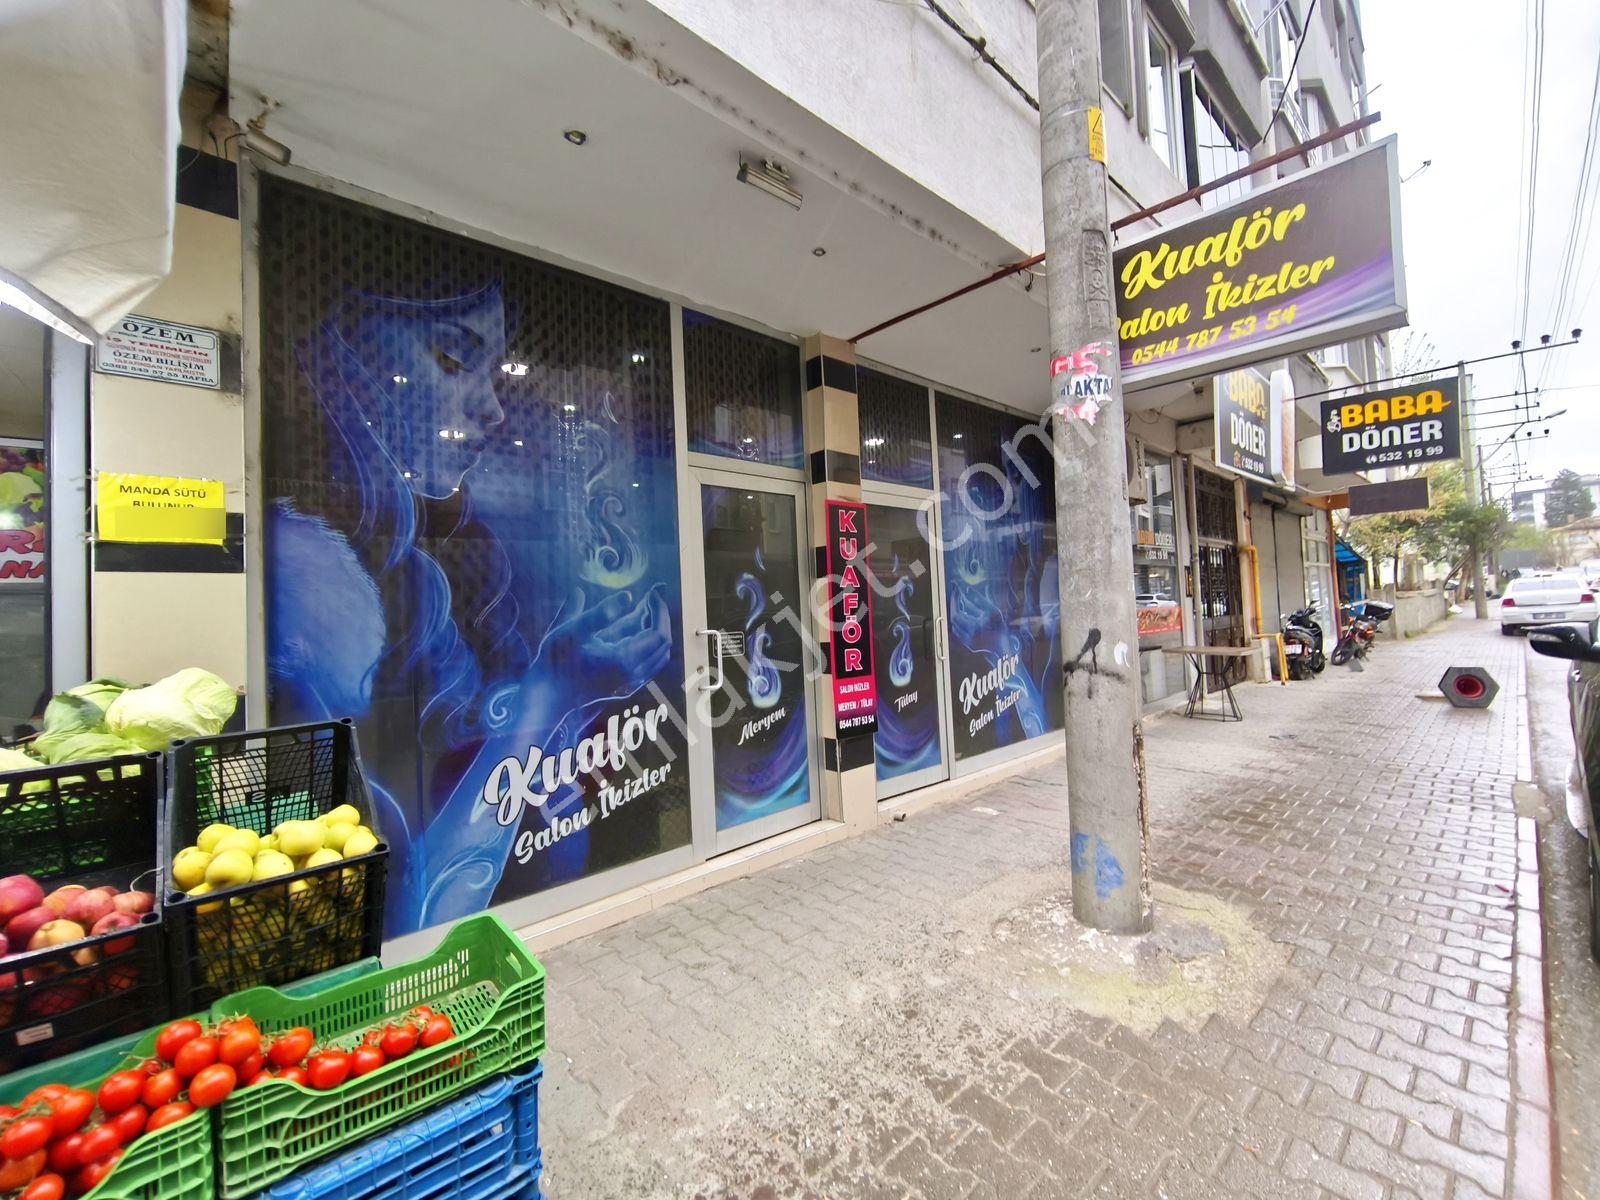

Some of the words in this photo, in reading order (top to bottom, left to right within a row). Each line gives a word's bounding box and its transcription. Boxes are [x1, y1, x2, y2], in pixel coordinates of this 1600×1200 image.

[1120, 203, 1306, 299] Kuaför
[1117, 303, 1191, 340] alon
[1203, 255, 1335, 320] İkizler
[112, 350, 153, 363] ÖZEM
[1131, 336, 1179, 366] 0544
[1186, 325, 1224, 351] 787
[1229, 315, 1257, 340] 53
[1266, 304, 1297, 331] 54
[1340, 390, 1452, 429] BABA
[1230, 411, 1267, 458] DÖNER
[1342, 418, 1444, 453] DÖNER
[1378, 450, 1403, 462] 532
[1407, 448, 1423, 459] 19
[1426, 445, 1444, 456] 99
[119, 484, 171, 497] MANDA
[174, 487, 207, 499] SÜTÜ
[838, 509, 864, 673] KUAFÖR
[894, 690, 919, 713] Tülay
[958, 654, 1019, 715] Kuaför
[737, 705, 787, 746] Meryem
[969, 709, 994, 738] Salon
[483, 703, 668, 827] Kuaför
[514, 806, 592, 865] Salon
[597, 761, 672, 821] İkizler
